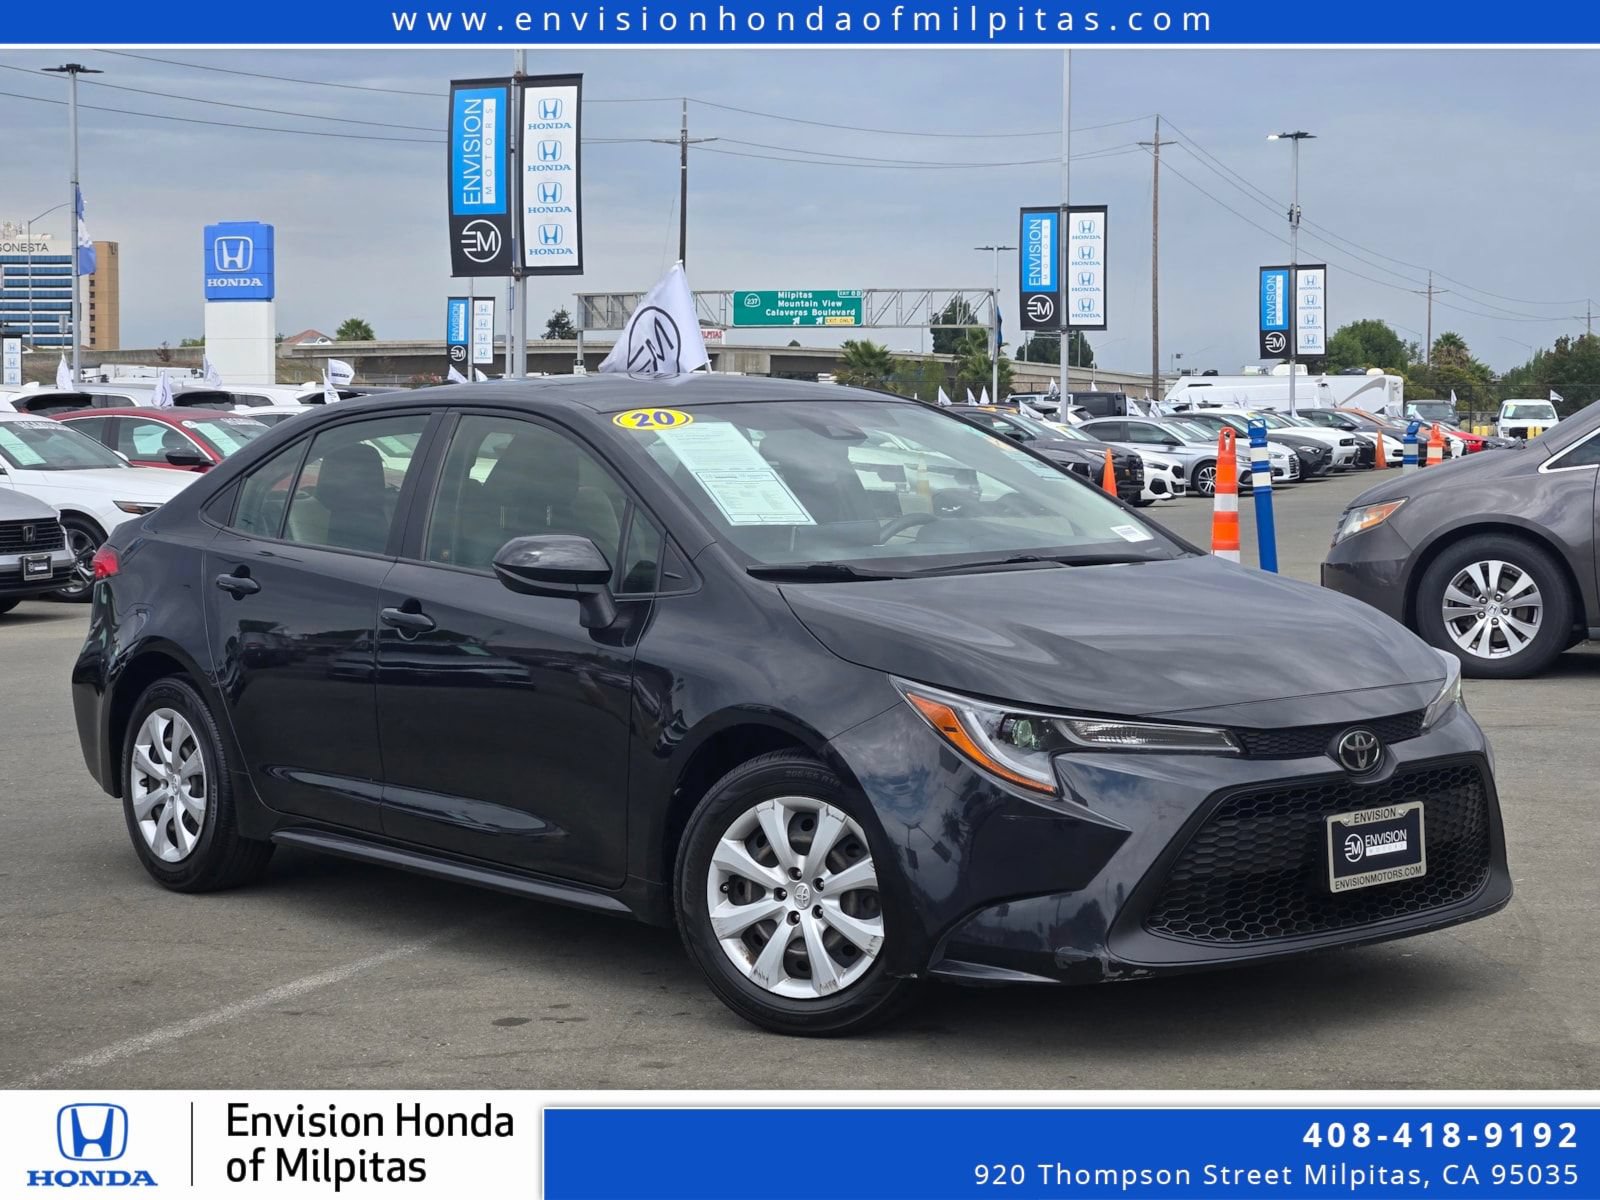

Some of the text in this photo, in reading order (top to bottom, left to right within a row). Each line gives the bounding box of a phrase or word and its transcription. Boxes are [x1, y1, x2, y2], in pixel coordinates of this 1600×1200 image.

[528, 122, 572, 130] HONDA
[463, 99, 481, 205] ENVISION
[485, 108, 493, 195] MOTORS
[527, 164, 571, 172] HONDA
[528, 206, 572, 214] HONDA
[529, 248, 574, 256] HONDA
[1029, 219, 1041, 286] ENVISION
[207, 278, 264, 287] HONDA
[777, 291, 813, 300] Milpitas
[1266, 275, 1276, 326] ENVISION
[777, 300, 819, 308] Mountain
[765, 308, 856, 316] Calaveras Boulevard
[631, 411, 675, 427] 20
[1354, 808, 1397, 824] ENVISION
[1365, 829, 1407, 847] ENVISION
[1335, 865, 1422, 890] ENVISIONMOTORS.COM
